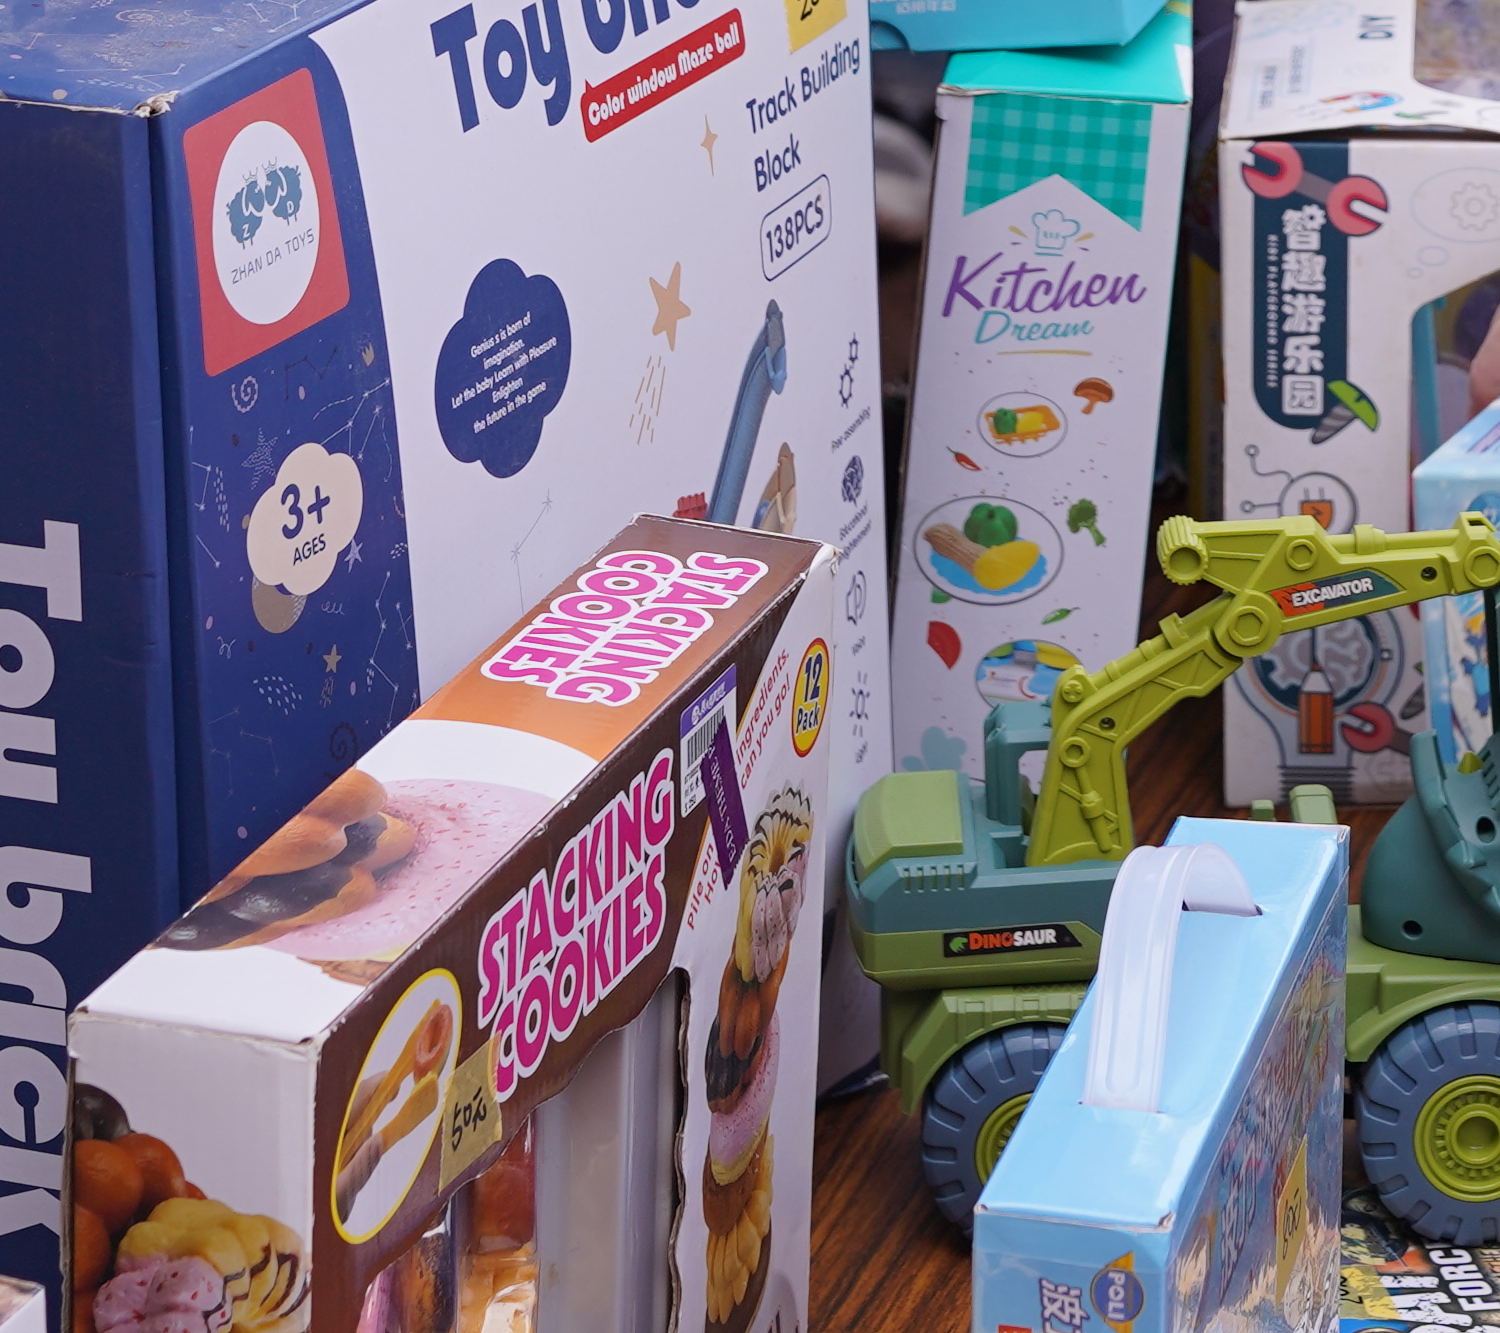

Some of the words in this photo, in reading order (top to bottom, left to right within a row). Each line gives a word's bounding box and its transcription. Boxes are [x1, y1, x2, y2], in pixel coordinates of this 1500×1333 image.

[1357, 14, 1397, 40] DIY
[587, 90, 627, 127] Color
[626, 61, 678, 106] window
[678, 41, 714, 79] Maze
[714, 22, 740, 55] ball
[745, 76, 797, 135] Track
[801, 37, 861, 103] Building
[754, 133, 801, 193] Block
[231, 257, 264, 285] ZHAN
[266, 246, 283, 267] DA
[285, 228, 315, 256] TOYS
[765, 196, 826, 265] 138PCS
[1266, 233, 1280, 262] KIDS
[942, 252, 1148, 318] Kitchen
[1266, 265, 1280, 345] PLAYGROUND
[470, 336, 495, 358] Genius
[506, 319, 523, 337] born
[523, 311, 532, 327] of
[974, 309, 1095, 345] Dream
[451, 393, 464, 409] Let
[463, 385, 476, 400] the
[475, 374, 495, 395] baby
[494, 363, 515, 384] Learn
[514, 352, 530, 372] with
[529, 336, 558, 362] Pleasure
[491, 377, 524, 404] Enlighten
[1266, 348, 1279, 389] SERIES
[473, 419, 487, 434] the
[485, 405, 507, 427] future
[514, 392, 527, 408] the
[526, 381, 547, 404] game
[278, 479, 333, 539] 3+
[292, 533, 328, 567] AGES
[485, 551, 678, 684] COOKIES
[1290, 577, 1375, 608] EXCAVATOR
[552, 552, 766, 705] STACKING
[803, 652, 824, 703] 12
[739, 750, 758, 790] can
[755, 714, 775, 757] you
[774, 673, 792, 712] go!
[796, 703, 821, 734] Pack
[687, 880, 703, 930] Pile
[701, 843, 715, 875] on
[735, 648, 791, 765] ingredients.
[478, 748, 675, 1029] STACKING
[969, 928, 1057, 951] DINOSAUR
[495, 858, 666, 1103] COOKIES
[1040, 1277, 1091, 1333] 波
[1108, 1271, 1126, 1321] POLI
